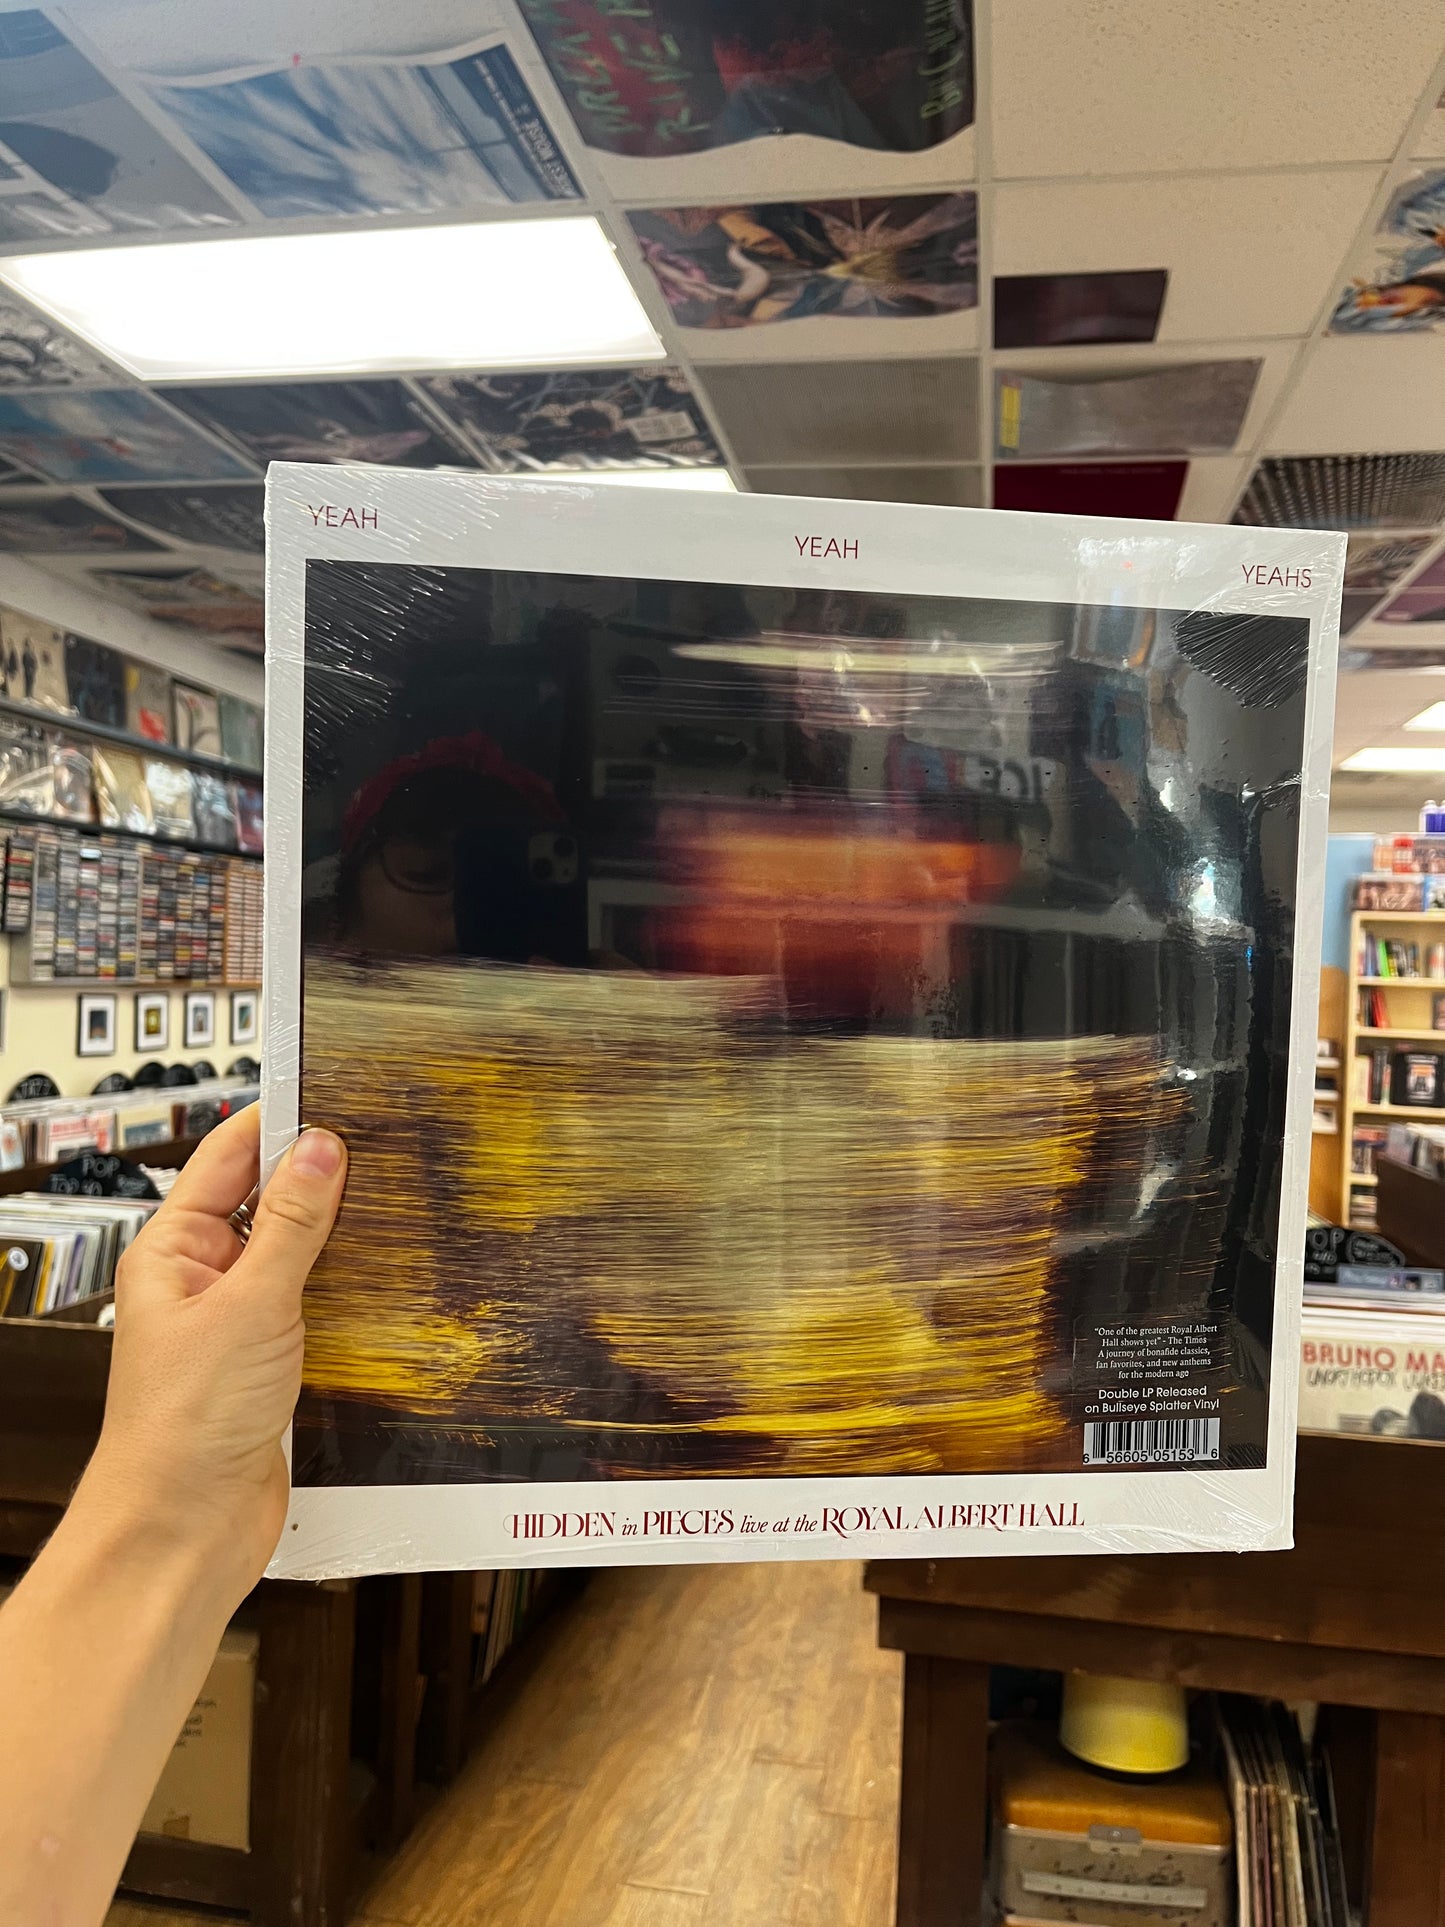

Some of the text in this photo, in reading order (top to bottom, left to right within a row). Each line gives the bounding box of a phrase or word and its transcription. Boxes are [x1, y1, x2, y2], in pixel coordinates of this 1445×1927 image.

[308, 505, 1312, 588] YEAH YEAH YEAHS
[82, 1153, 121, 1178] POP
[1116, 1326, 1125, 1336] of
[1126, 1326, 1138, 1335] the
[1139, 1326, 1170, 1337] greatest
[1171, 1325, 1192, 1335] Royal
[1194, 1324, 1217, 1333] Albert
[1102, 1338, 1118, 1347] Hall
[1120, 1337, 1144, 1346] shows
[1168, 1336, 1182, 1345] The
[1184, 1336, 1207, 1344] Times
[1098, 1346, 1210, 1359] A journey of bonafide classics,
[1303, 1342, 1397, 1371] BRUNO
[1096, 1357, 1211, 1369] fan favorites, and new anthems
[1118, 1369, 1189, 1379] for the modern age
[1099, 1386, 1207, 1399] Double LP Released
[1085, 1398, 1219, 1413] on Bullseye Splatter Vinyl
[1083, 1448, 1218, 1464] 6 56605 05153 6
[503, 1502, 1085, 1539] HIDDEN in PIECES live at the ROYAL ALBERT HALL
